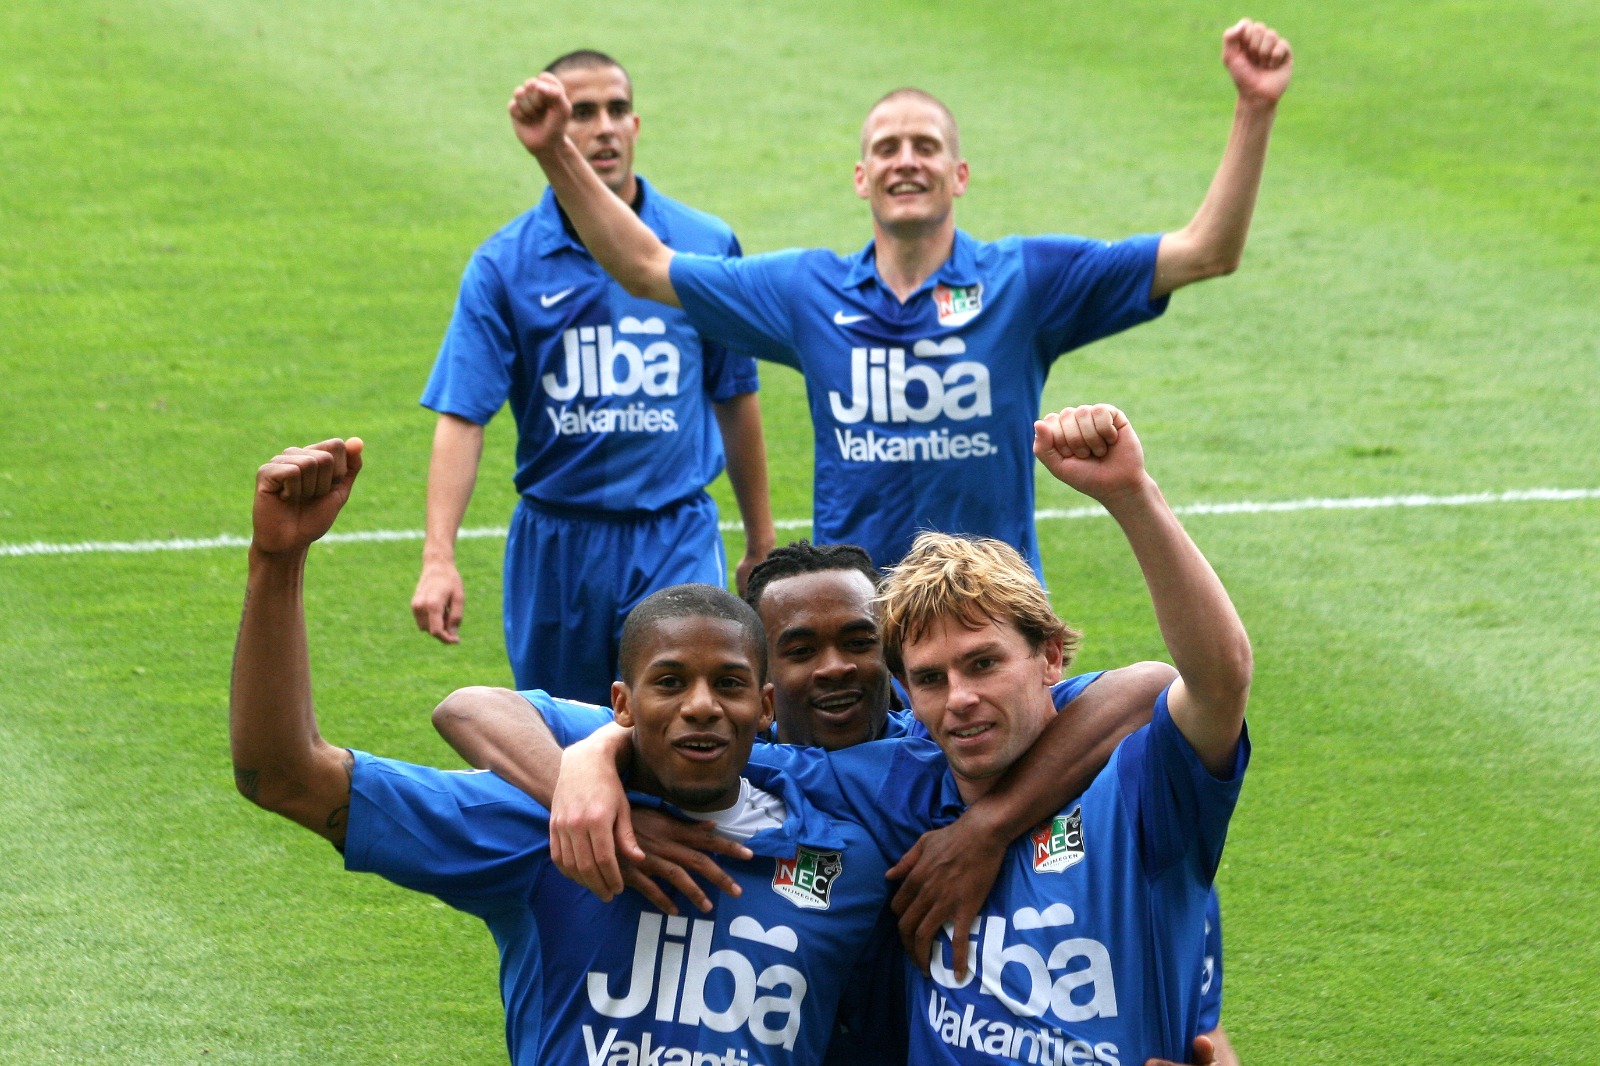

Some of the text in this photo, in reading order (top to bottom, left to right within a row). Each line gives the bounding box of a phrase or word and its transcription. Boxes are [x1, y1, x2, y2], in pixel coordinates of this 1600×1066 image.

[542, 325, 680, 400] Jiba
[828, 347, 992, 424] Jiba
[835, 428, 998, 462] Vakanties.
[1037, 831, 1080, 858] NEC
[1042, 853, 1078, 867] NIJMEGEN
[780, 864, 828, 894] NEC
[782, 886, 820, 904] NIJMEGEN
[587, 911, 807, 1052] Jiba
[928, 989, 1121, 1066] Vakanties
